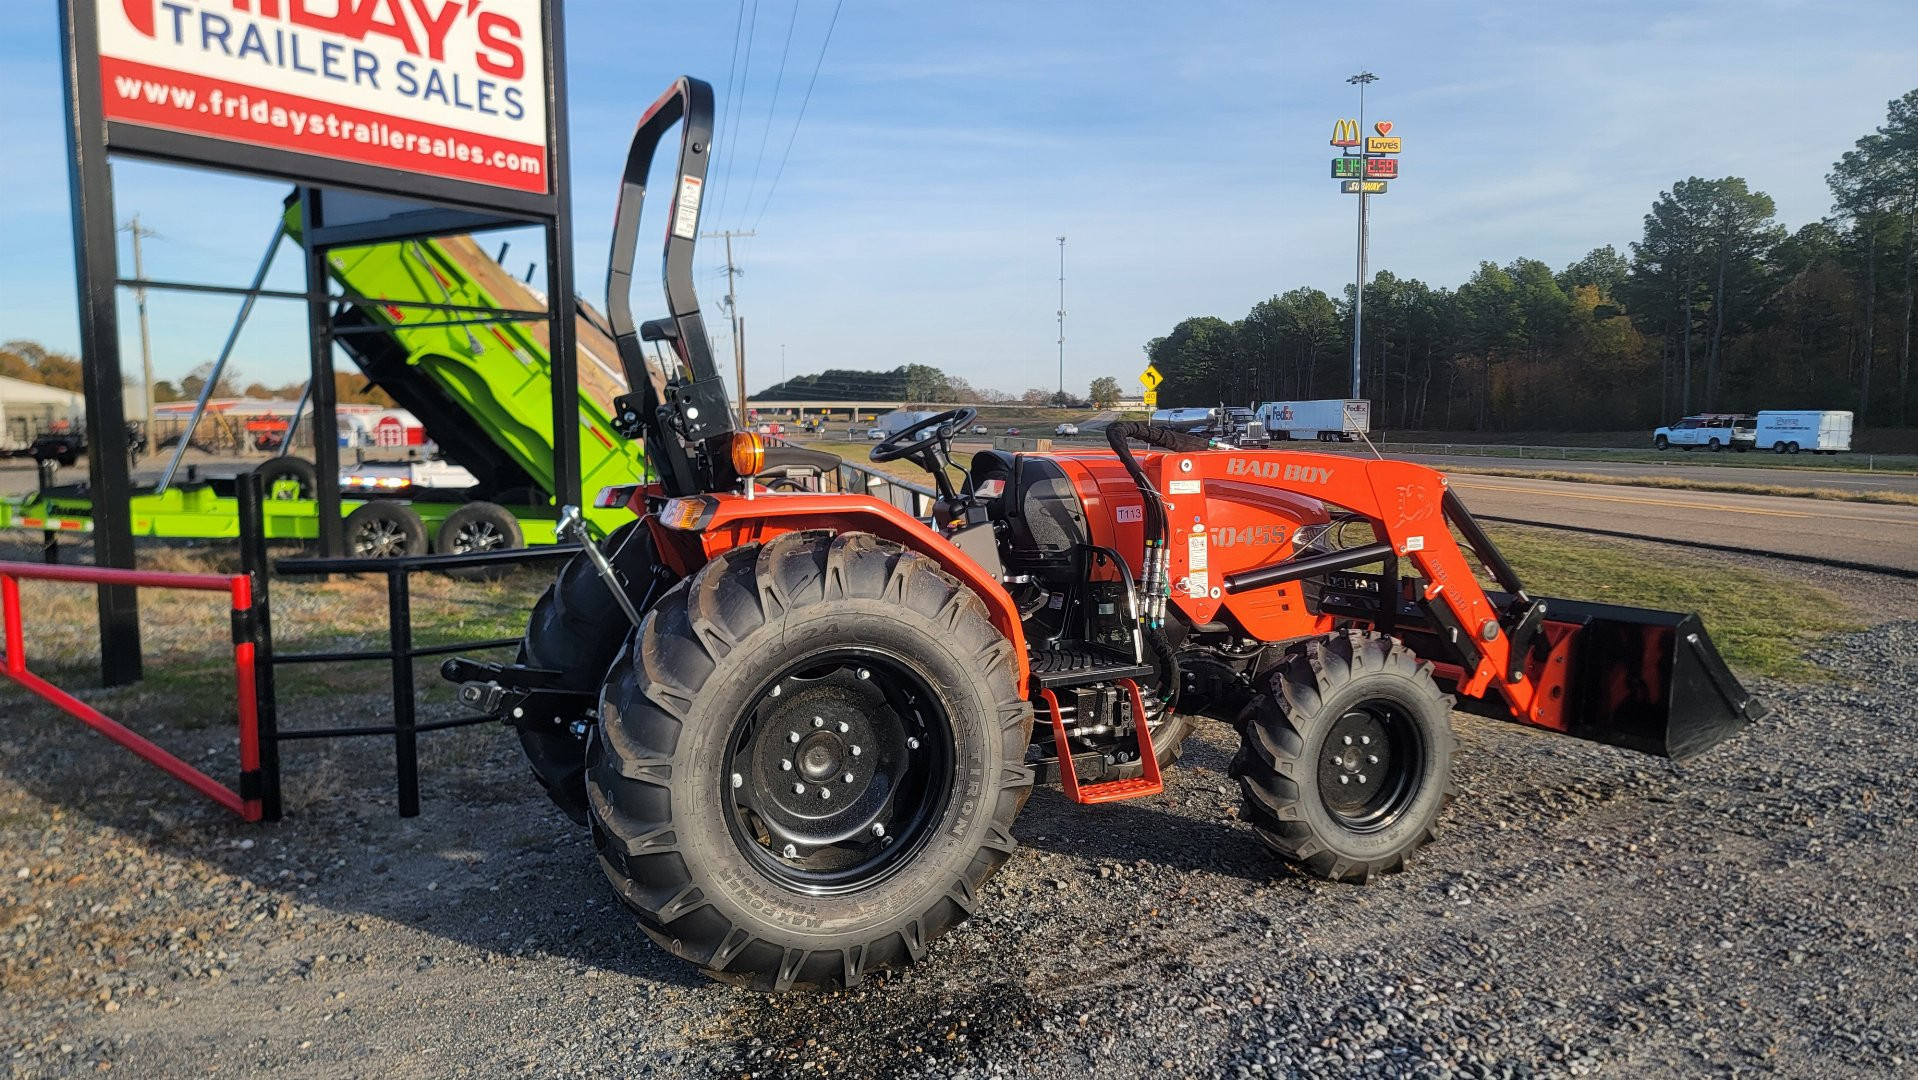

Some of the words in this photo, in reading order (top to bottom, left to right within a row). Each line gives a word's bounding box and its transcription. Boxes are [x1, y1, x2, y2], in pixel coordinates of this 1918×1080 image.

[162, 2, 380, 90] TRAILER
[395, 60, 526, 121] SALES
[115, 75, 541, 175] www.fridaystrailersales.com
[1272, 405, 1294, 421] FedEx
[1226, 457, 1280, 479] BAD
[1283, 463, 1335, 485] BOY
[1118, 508, 1142, 520] T113
[952, 748, 983, 837] TIRON
